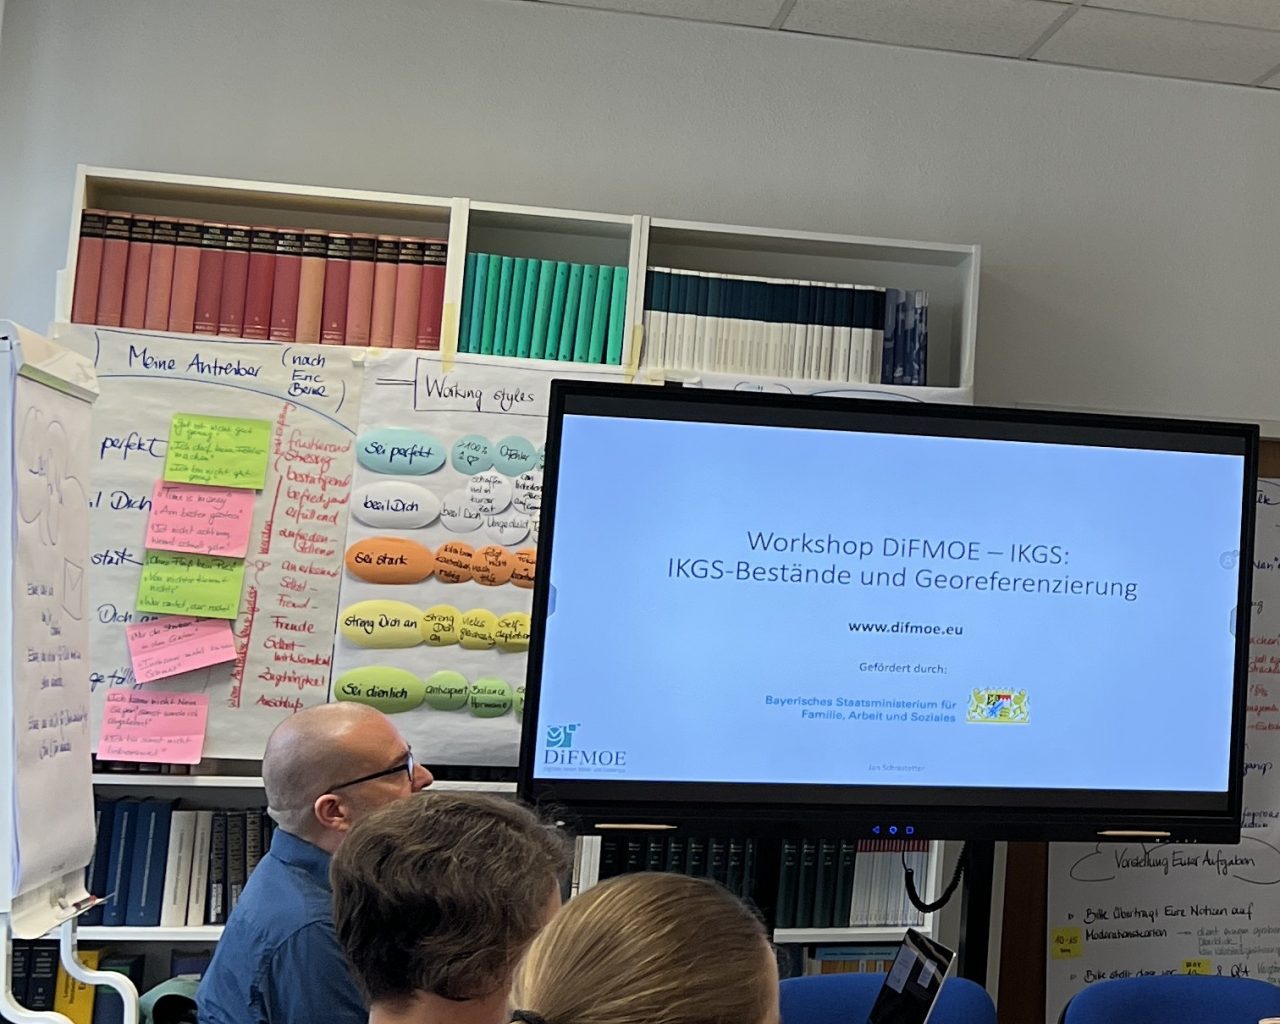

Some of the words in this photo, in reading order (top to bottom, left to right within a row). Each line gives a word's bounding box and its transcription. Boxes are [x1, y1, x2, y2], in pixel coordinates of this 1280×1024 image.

[129, 344, 176, 371] Meine
[426, 375, 483, 412] Working
[493, 383, 535, 411] styles
[365, 441, 386, 456] Sei
[110, 491, 152, 512] Dich
[747, 530, 874, 560] Workshop
[883, 537, 980, 561] DiFMOE
[1010, 544, 1070, 565] IKGS:
[355, 552, 372, 564] Sei
[376, 552, 408, 566] stark
[667, 558, 851, 585] IKGS-Bestände
[861, 566, 905, 587] und
[915, 569, 1139, 601] Georeferenzierung
[97, 604, 132, 624] Dich
[848, 621, 964, 636] www.difmoe.eu
[859, 662, 911, 674] Gefördert
[913, 663, 948, 675] durch:
[765, 695, 833, 708] Bayerisches
[836, 697, 938, 710] Staatsministerium
[941, 699, 957, 710] für
[801, 710, 846, 721] Familie,
[848, 710, 883, 722] Arbeit
[886, 711, 908, 722] und
[910, 711, 956, 723] Soziales
[543, 750, 627, 766] DiFMOE
[1164, 904, 1186, 918] Eure
[1231, 902, 1254, 919] auf
